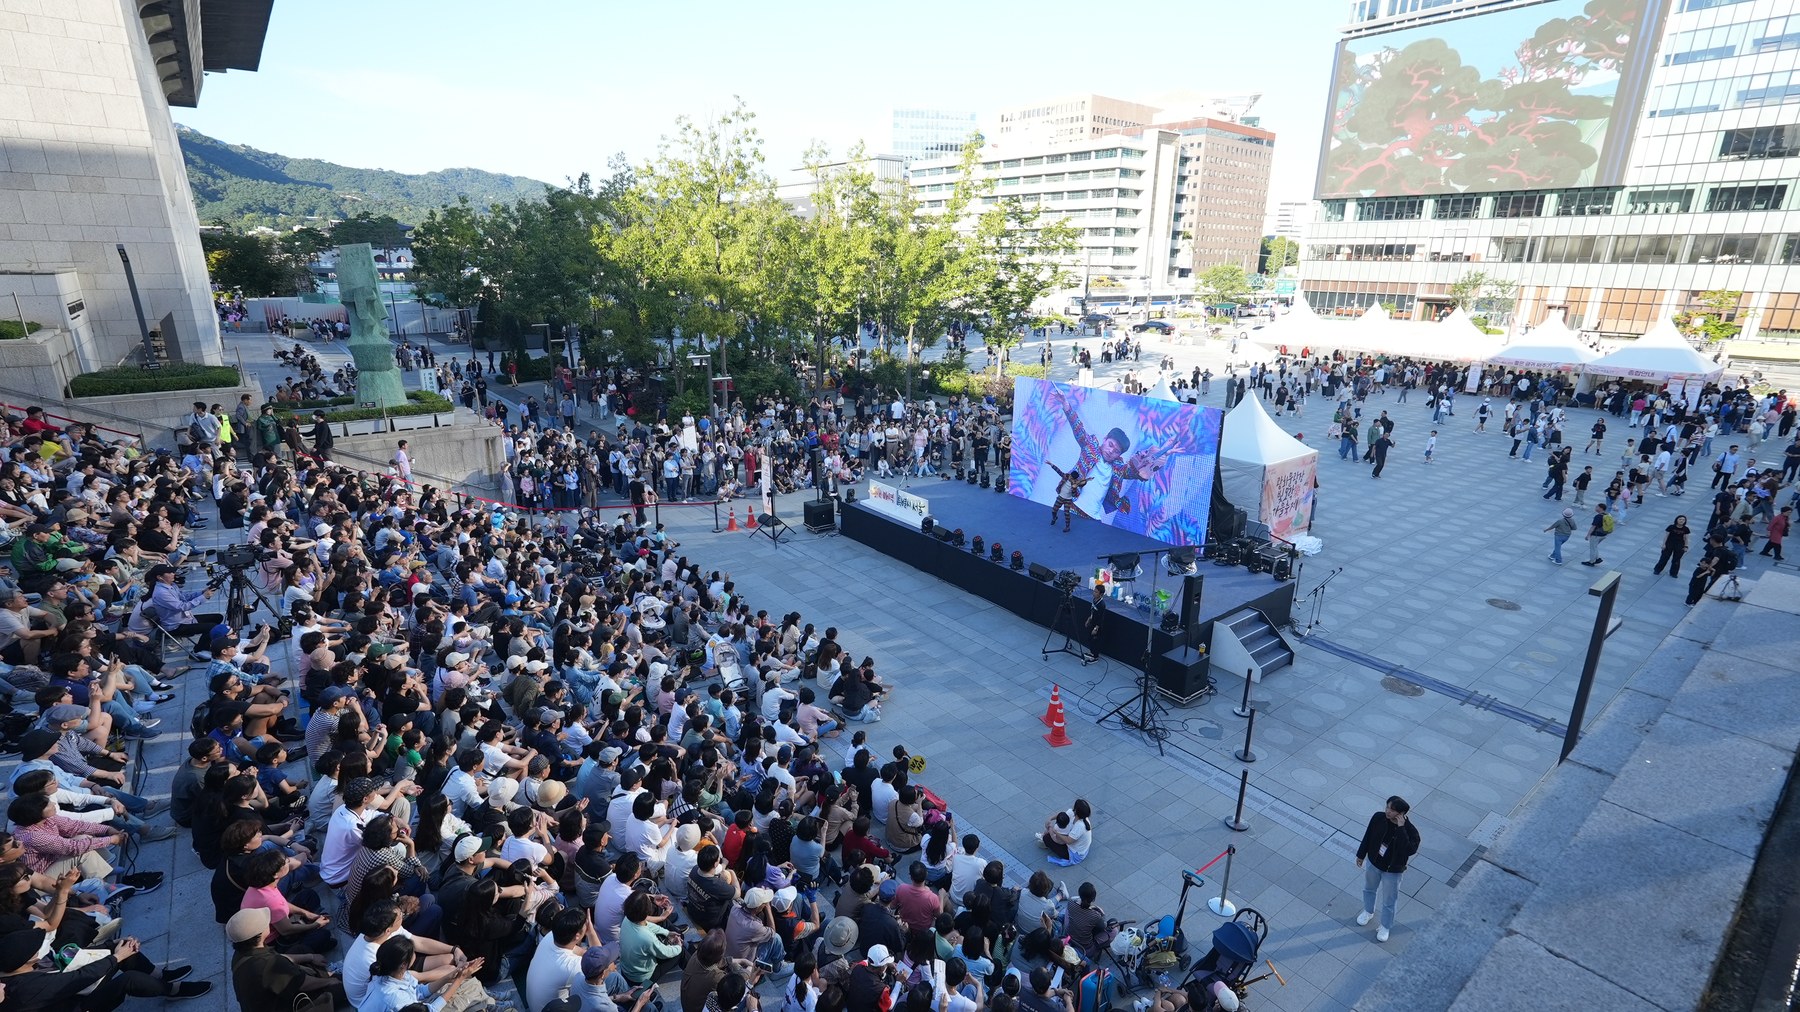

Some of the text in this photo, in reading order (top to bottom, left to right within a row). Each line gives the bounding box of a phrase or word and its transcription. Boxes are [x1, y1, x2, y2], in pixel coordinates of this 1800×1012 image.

[1627, 369, 1655, 377] 종합안내
[1276, 470, 1305, 490] 광화문광장
[912, 501, 926, 516] 서울
[1272, 497, 1299, 518] 가을축제
